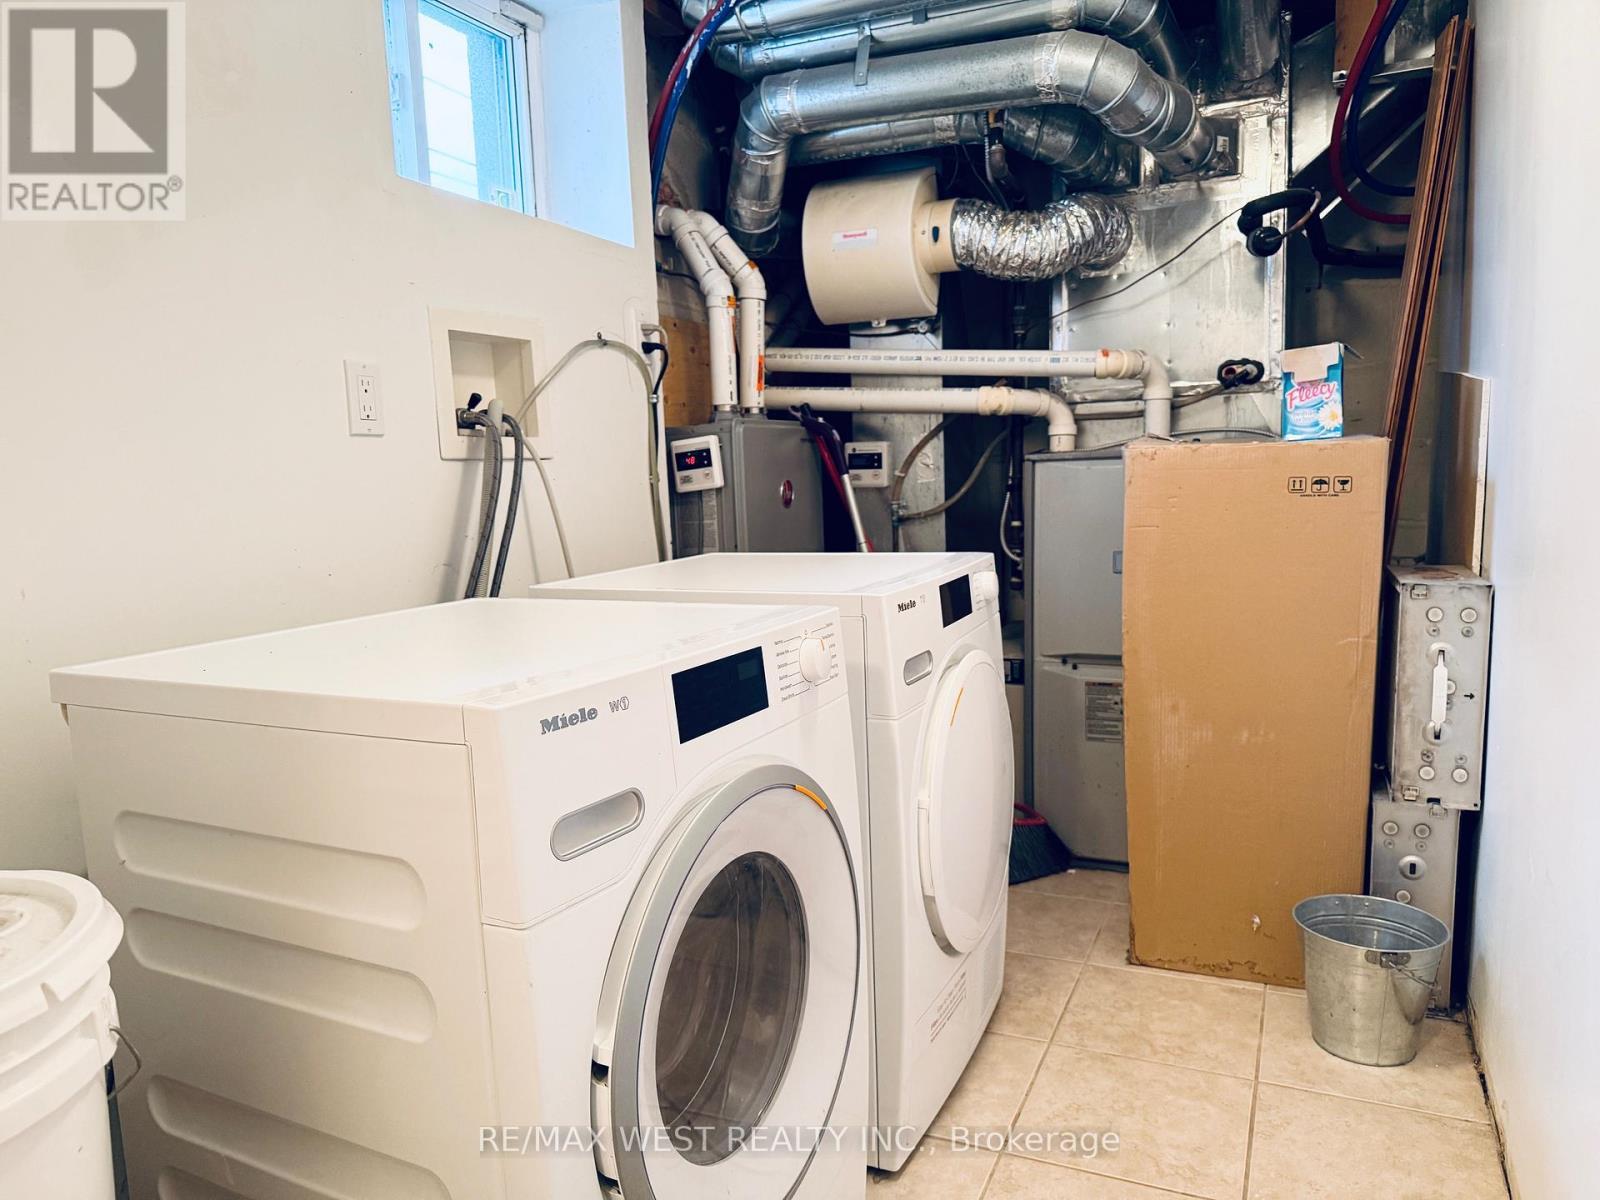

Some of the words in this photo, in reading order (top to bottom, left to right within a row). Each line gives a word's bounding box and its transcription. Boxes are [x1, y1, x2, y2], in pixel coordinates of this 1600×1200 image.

[1286, 382, 1337, 410] Fleecy
[897, 599, 917, 613] Miele
[539, 707, 599, 735] Miele
